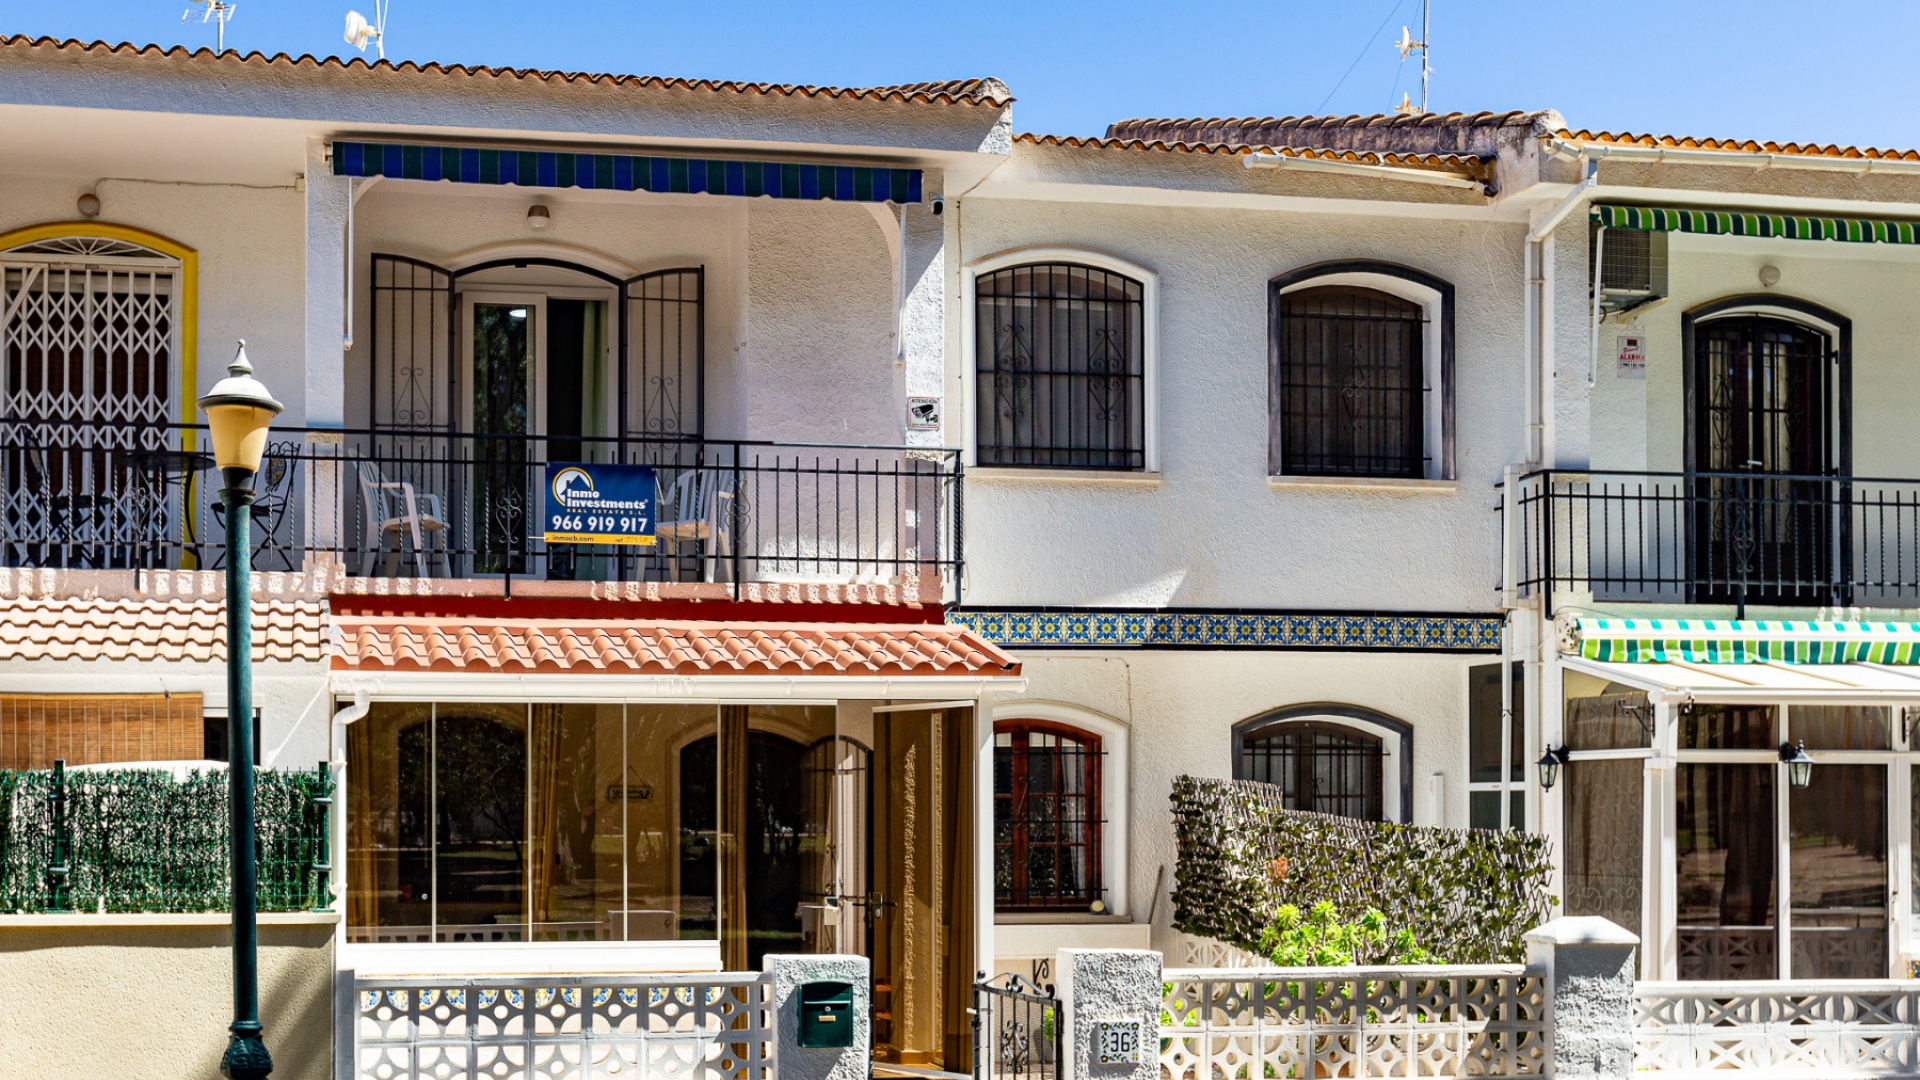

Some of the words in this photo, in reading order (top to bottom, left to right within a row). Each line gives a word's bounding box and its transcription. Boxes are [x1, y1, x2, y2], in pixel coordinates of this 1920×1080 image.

[567, 488, 600, 498] Inmo
[567, 498, 645, 509] Investments
[552, 515, 582, 530] 966
[587, 516, 615, 531] 919
[620, 517, 648, 532] 917
[1110, 1032, 1130, 1052] 36
